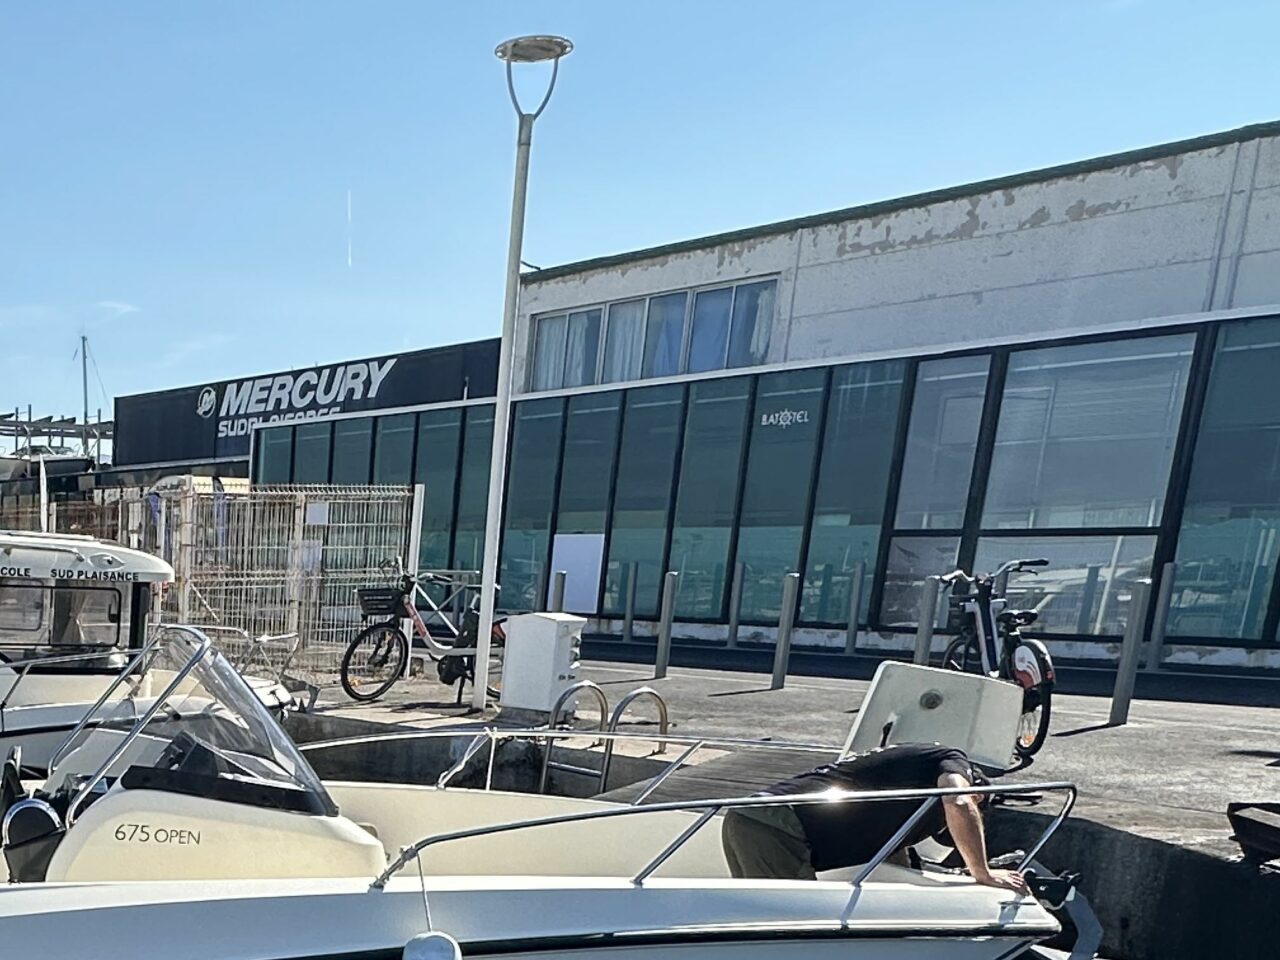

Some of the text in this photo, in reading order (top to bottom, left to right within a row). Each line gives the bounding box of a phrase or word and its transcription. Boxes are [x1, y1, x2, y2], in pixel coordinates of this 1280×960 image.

[218, 358, 398, 417] MERCURY
[51, 568, 74, 579] SUD
[77, 570, 139, 582] PLAISANCE
[114, 823, 201, 845] 675 OPEN
